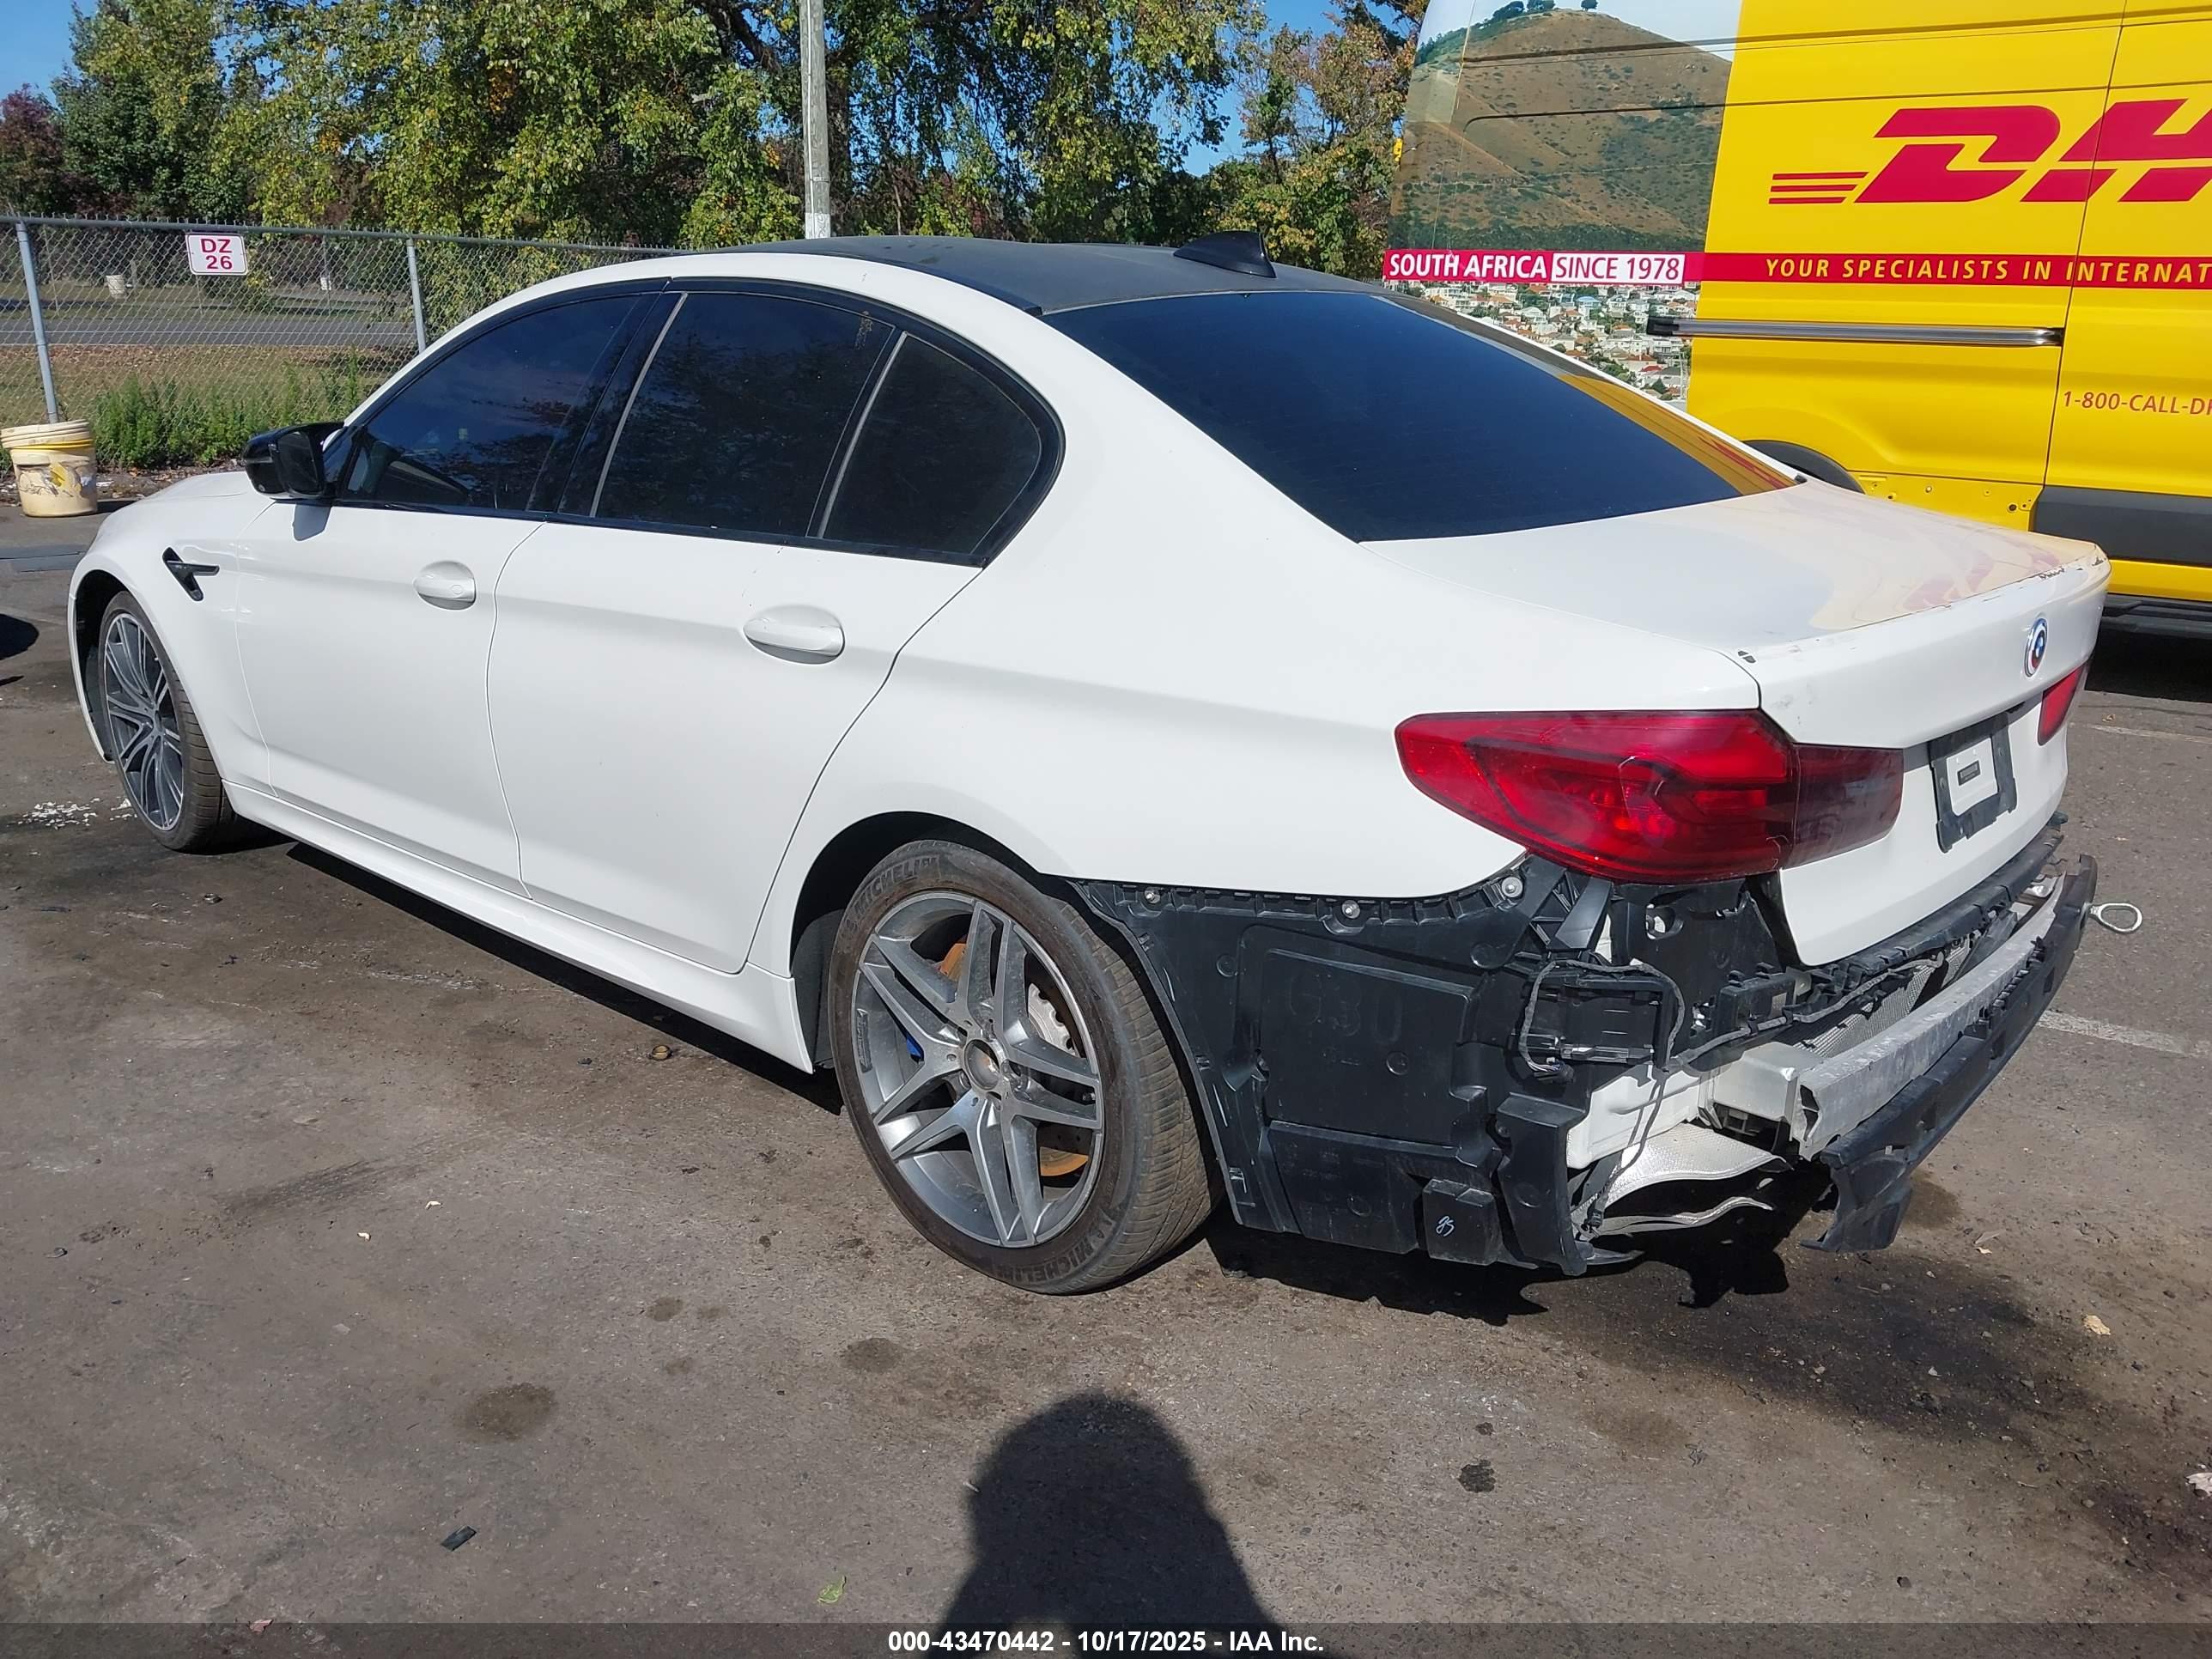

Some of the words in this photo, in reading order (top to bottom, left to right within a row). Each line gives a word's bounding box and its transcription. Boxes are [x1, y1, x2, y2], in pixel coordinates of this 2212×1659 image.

[200, 238, 233, 253] DZ
[206, 255, 233, 270] 26
[1389, 254, 1459, 276] SOUTH
[1462, 255, 1547, 279] AFRICA
[1555, 257, 1619, 279] SINCE
[1626, 257, 1680, 280] 1978
[1765, 258, 1828, 278] YOUR
[1841, 259, 2008, 280] SPECIALISTS
[2022, 260, 2051, 281] IN
[2065, 261, 2212, 283] INTERNAT
